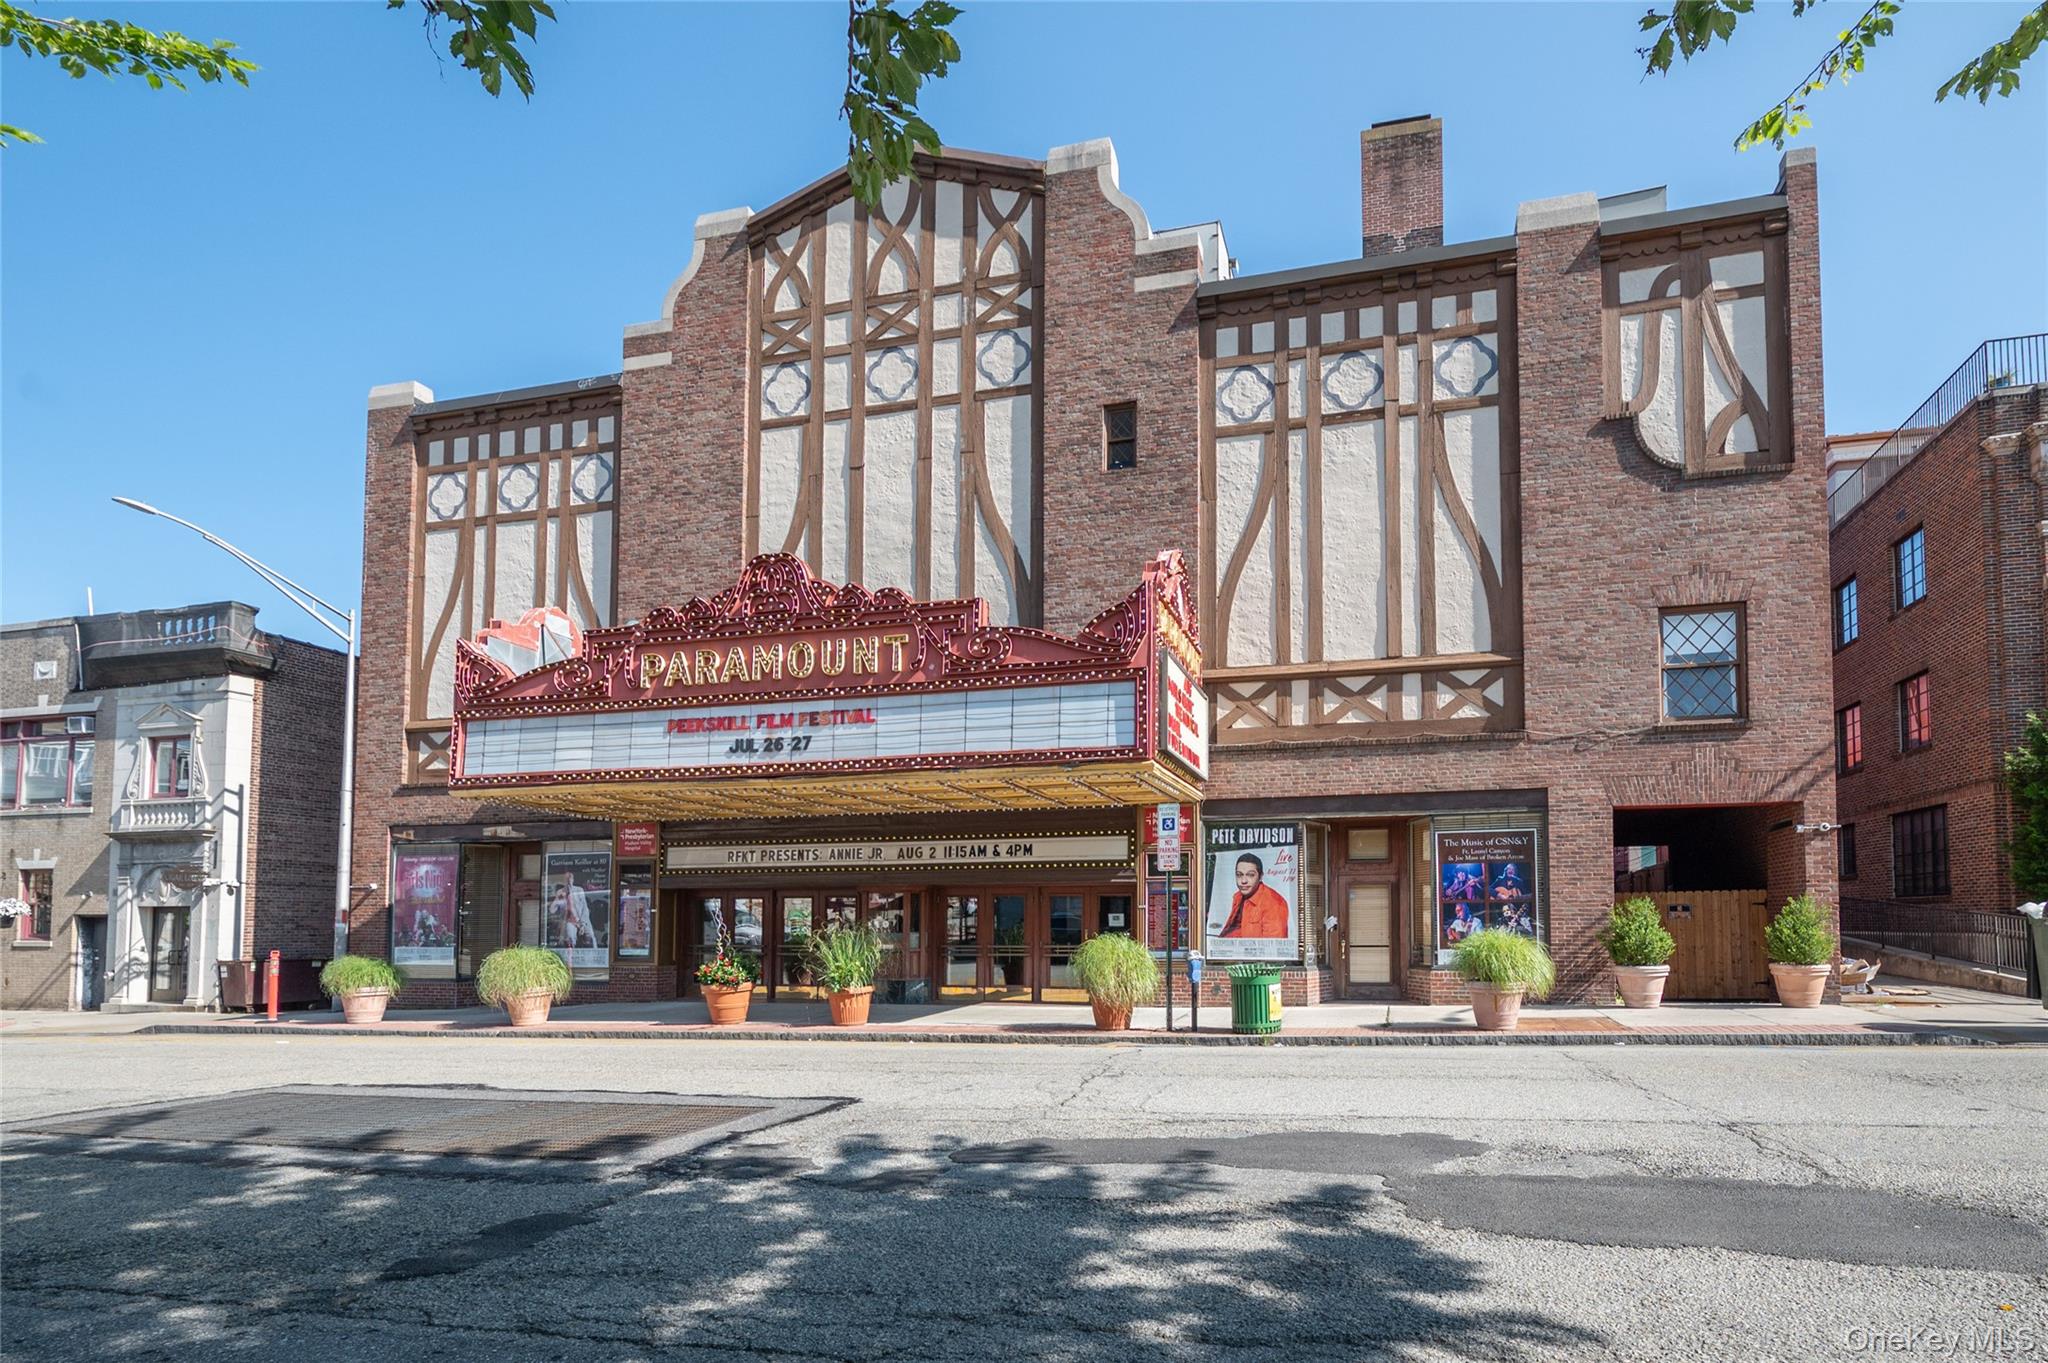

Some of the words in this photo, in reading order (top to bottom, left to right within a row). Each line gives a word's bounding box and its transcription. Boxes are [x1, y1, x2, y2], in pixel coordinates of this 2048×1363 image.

[639, 634, 909, 689] PARAMOUNT
[667, 715, 750, 734] PEEKSKILL
[756, 712, 794, 730] FILM
[799, 708, 877, 727] FESTIVAL
[729, 738, 759, 754] JUL
[1211, 828, 1236, 844] PETE
[1239, 827, 1294, 844] DAVIDSON
[1443, 838, 1459, 847] The
[1461, 838, 1482, 847] Music
[1485, 837, 1495, 846] of
[1495, 836, 1529, 846] CSN&Y
[727, 850, 756, 863] RFKT
[828, 847, 864, 860] ANNIE
[896, 846, 924, 859] AUG
[928, 846, 937, 859] 2
[992, 844, 1001, 857] &
[1005, 843, 1034, 857] 4PM
[1274, 848, 1294, 865] Live
